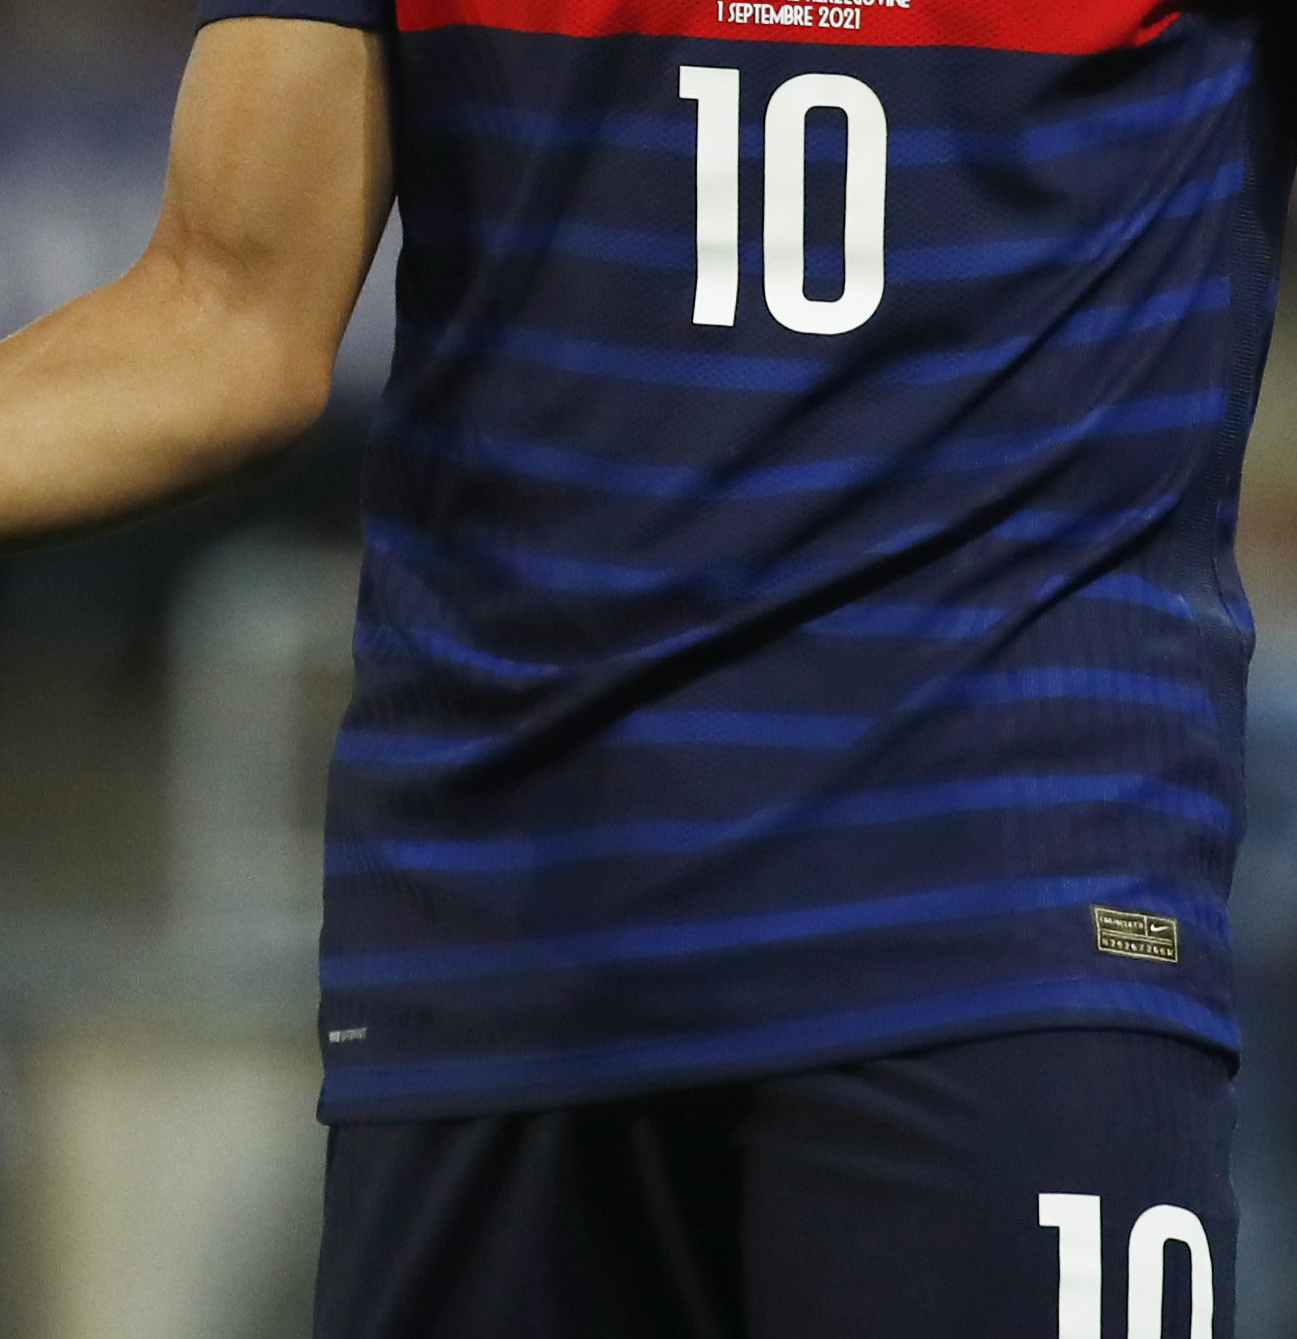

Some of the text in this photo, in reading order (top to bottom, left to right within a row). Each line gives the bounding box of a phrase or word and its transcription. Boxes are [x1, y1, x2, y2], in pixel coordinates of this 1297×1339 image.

[717, 0, 861, 29] 1 SEPTEMBRE 2021
[678, 65, 888, 335] 10
[1038, 1193, 1214, 1339] 10
